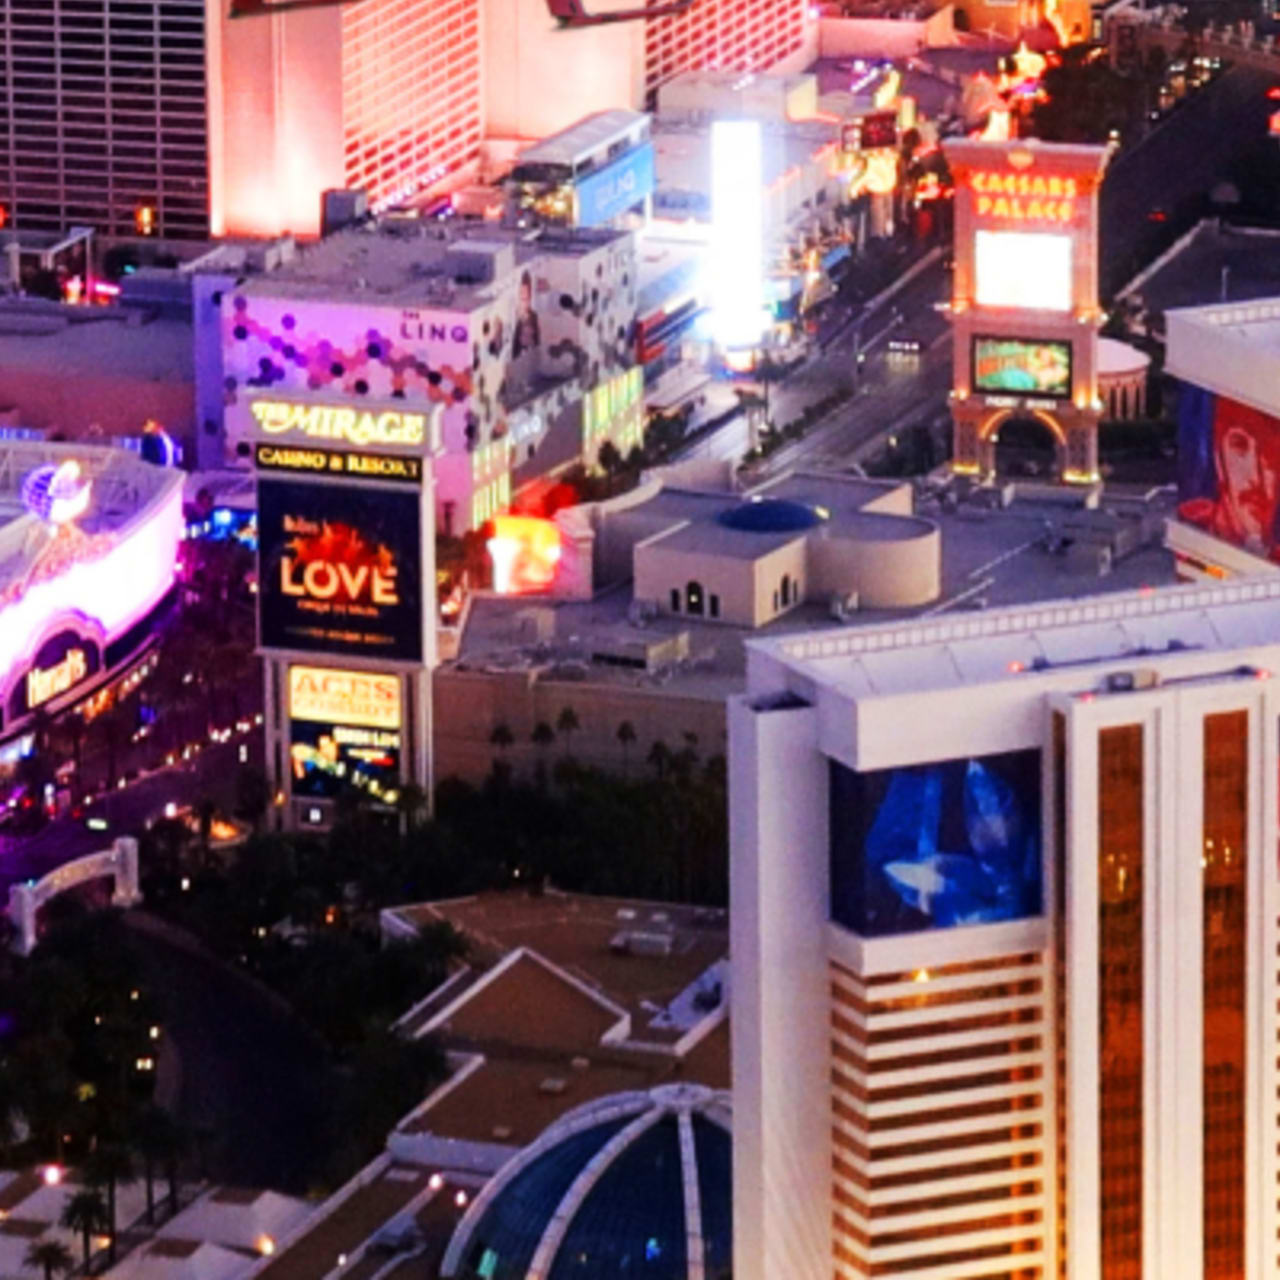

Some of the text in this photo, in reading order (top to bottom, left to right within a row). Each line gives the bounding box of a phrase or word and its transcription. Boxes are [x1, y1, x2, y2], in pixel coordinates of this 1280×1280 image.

[971, 172, 1077, 198] CAESARS
[976, 196, 1072, 221] PALACE
[400, 323, 468, 343] LINQ
[261, 403, 425, 446] MIRAGE
[258, 448, 326, 470] CASINO
[280, 556, 399, 605] LOVE
